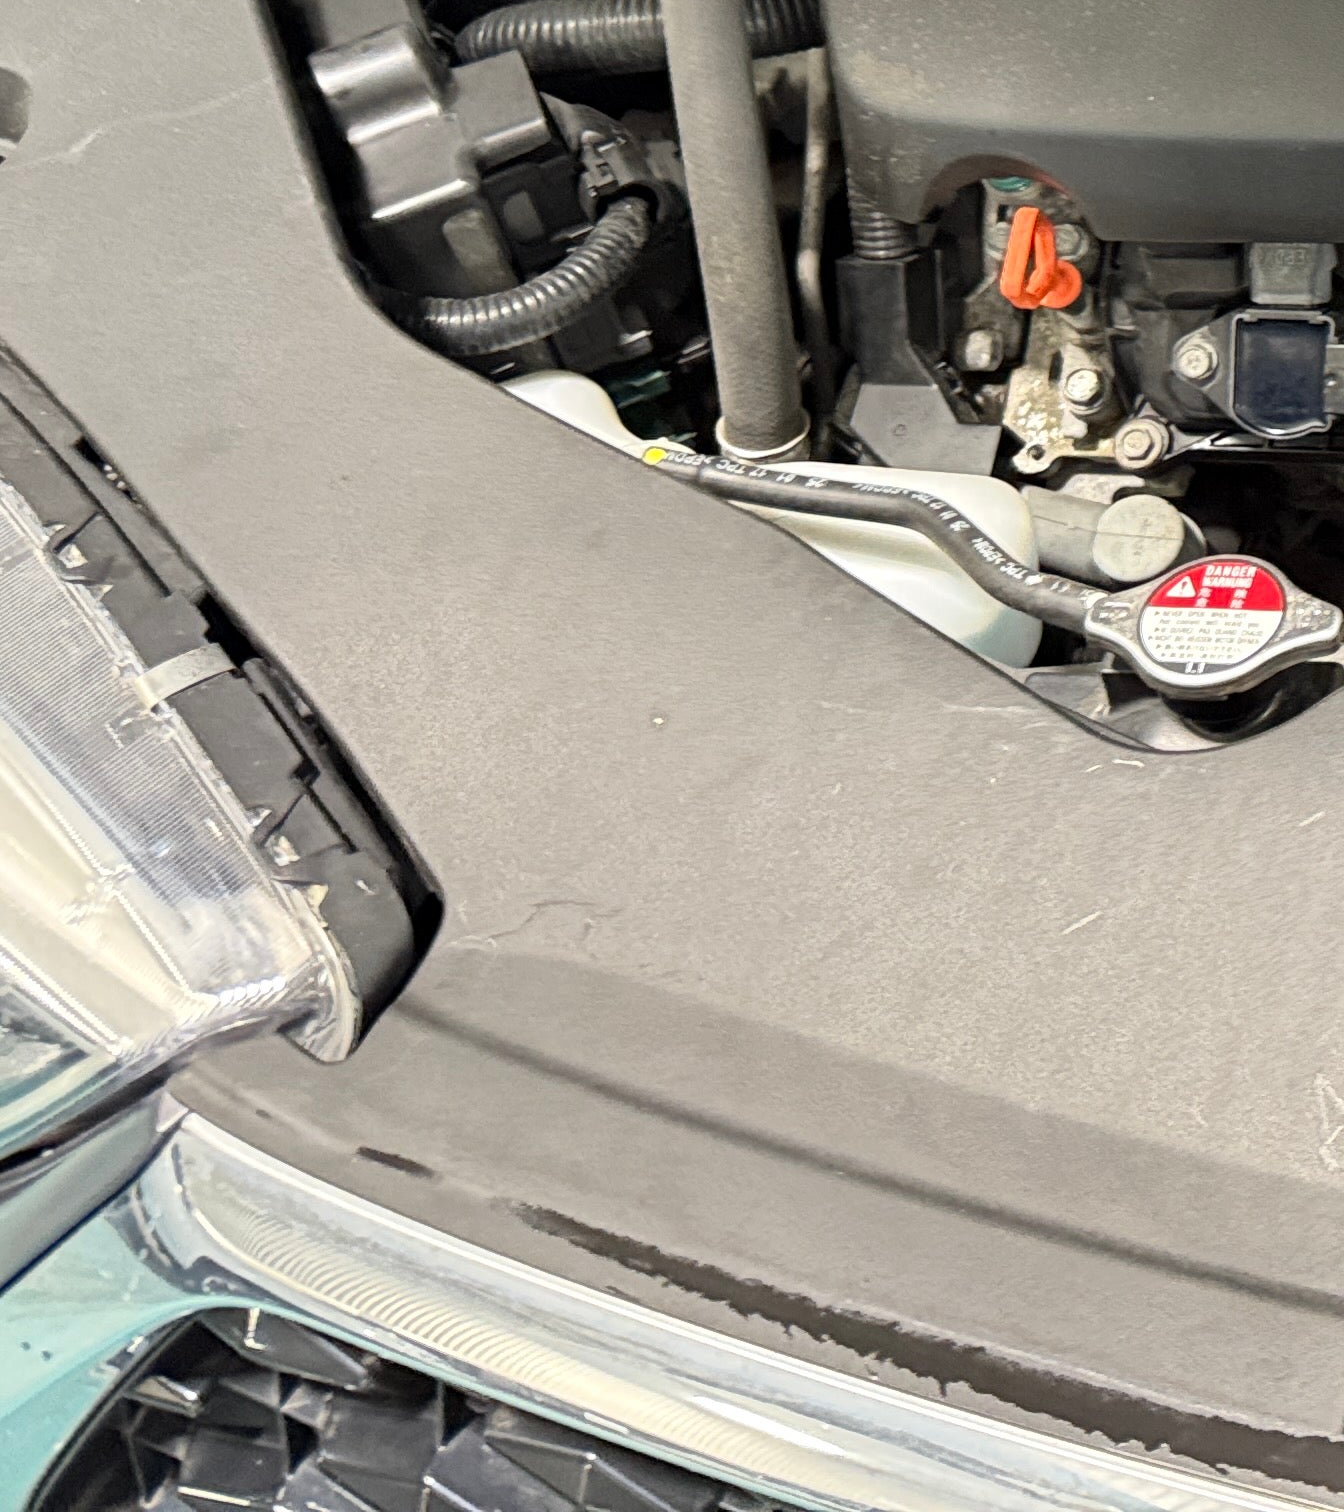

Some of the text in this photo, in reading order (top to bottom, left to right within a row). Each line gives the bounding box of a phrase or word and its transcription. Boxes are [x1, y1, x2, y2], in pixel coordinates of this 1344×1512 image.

[716, 459, 746, 474] TPC
[1000, 562, 1028, 580] TPC
[1205, 565, 1256, 577] DANGER
